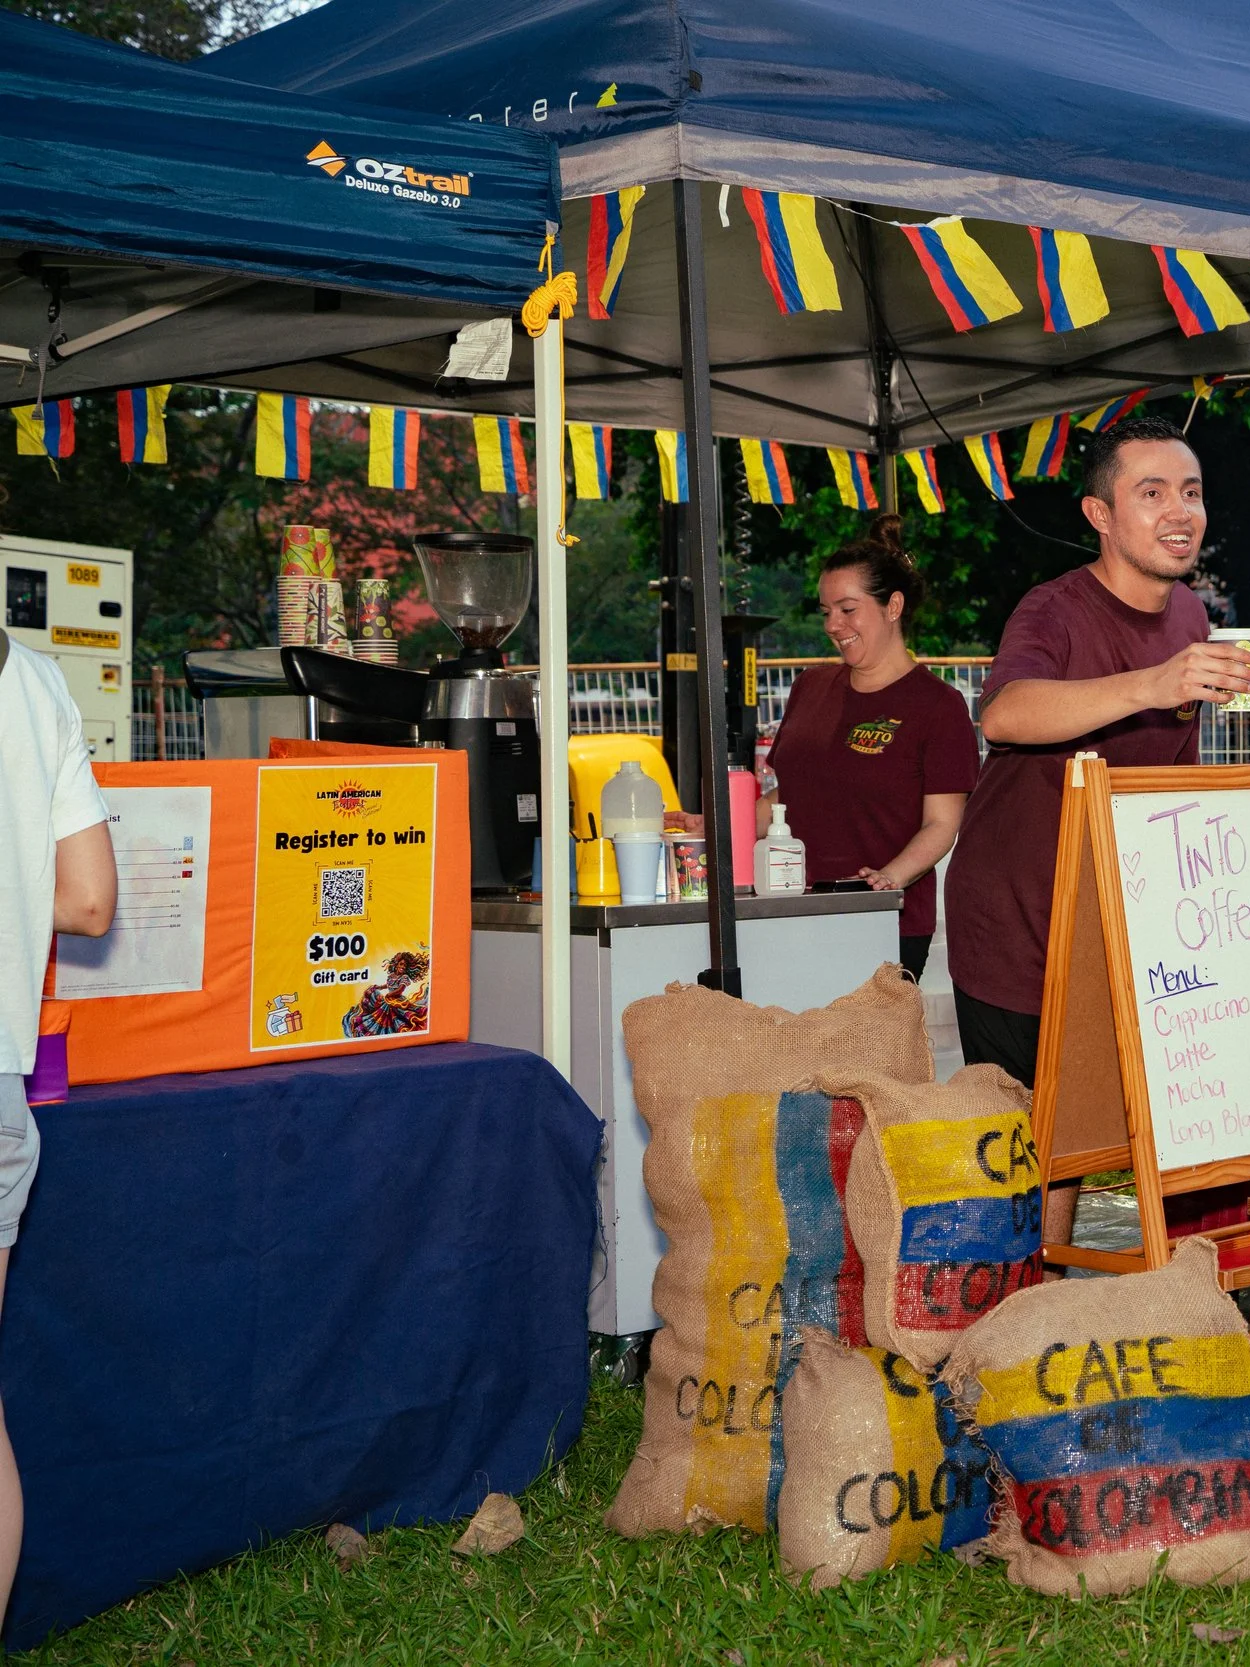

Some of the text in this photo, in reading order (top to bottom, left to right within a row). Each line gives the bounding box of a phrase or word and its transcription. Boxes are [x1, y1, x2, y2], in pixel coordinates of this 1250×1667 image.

[345, 174, 460, 208] Deluxe Gazebo 3.0
[69, 568, 99, 583] 1089
[853, 728, 892, 743] TINTO
[858, 738, 877, 748] NT
[316, 790, 382, 799] LATIN AMERICAN
[106, 814, 121, 822] ist
[275, 826, 425, 853] Register to win
[308, 934, 365, 962] $100
[313, 969, 369, 985] Gift card
[1148, 961, 1209, 994] Menu:
[1154, 996, 1250, 1043] Cappuccino
[1164, 1042, 1216, 1072] Latte
[1167, 1075, 1226, 1109] Mocha
[1169, 1118, 1215, 1146] Long
[922, 1254, 1043, 1316] COLO
[1036, 1336, 1188, 1406] CAFE
[1080, 1403, 1143, 1454] DE
